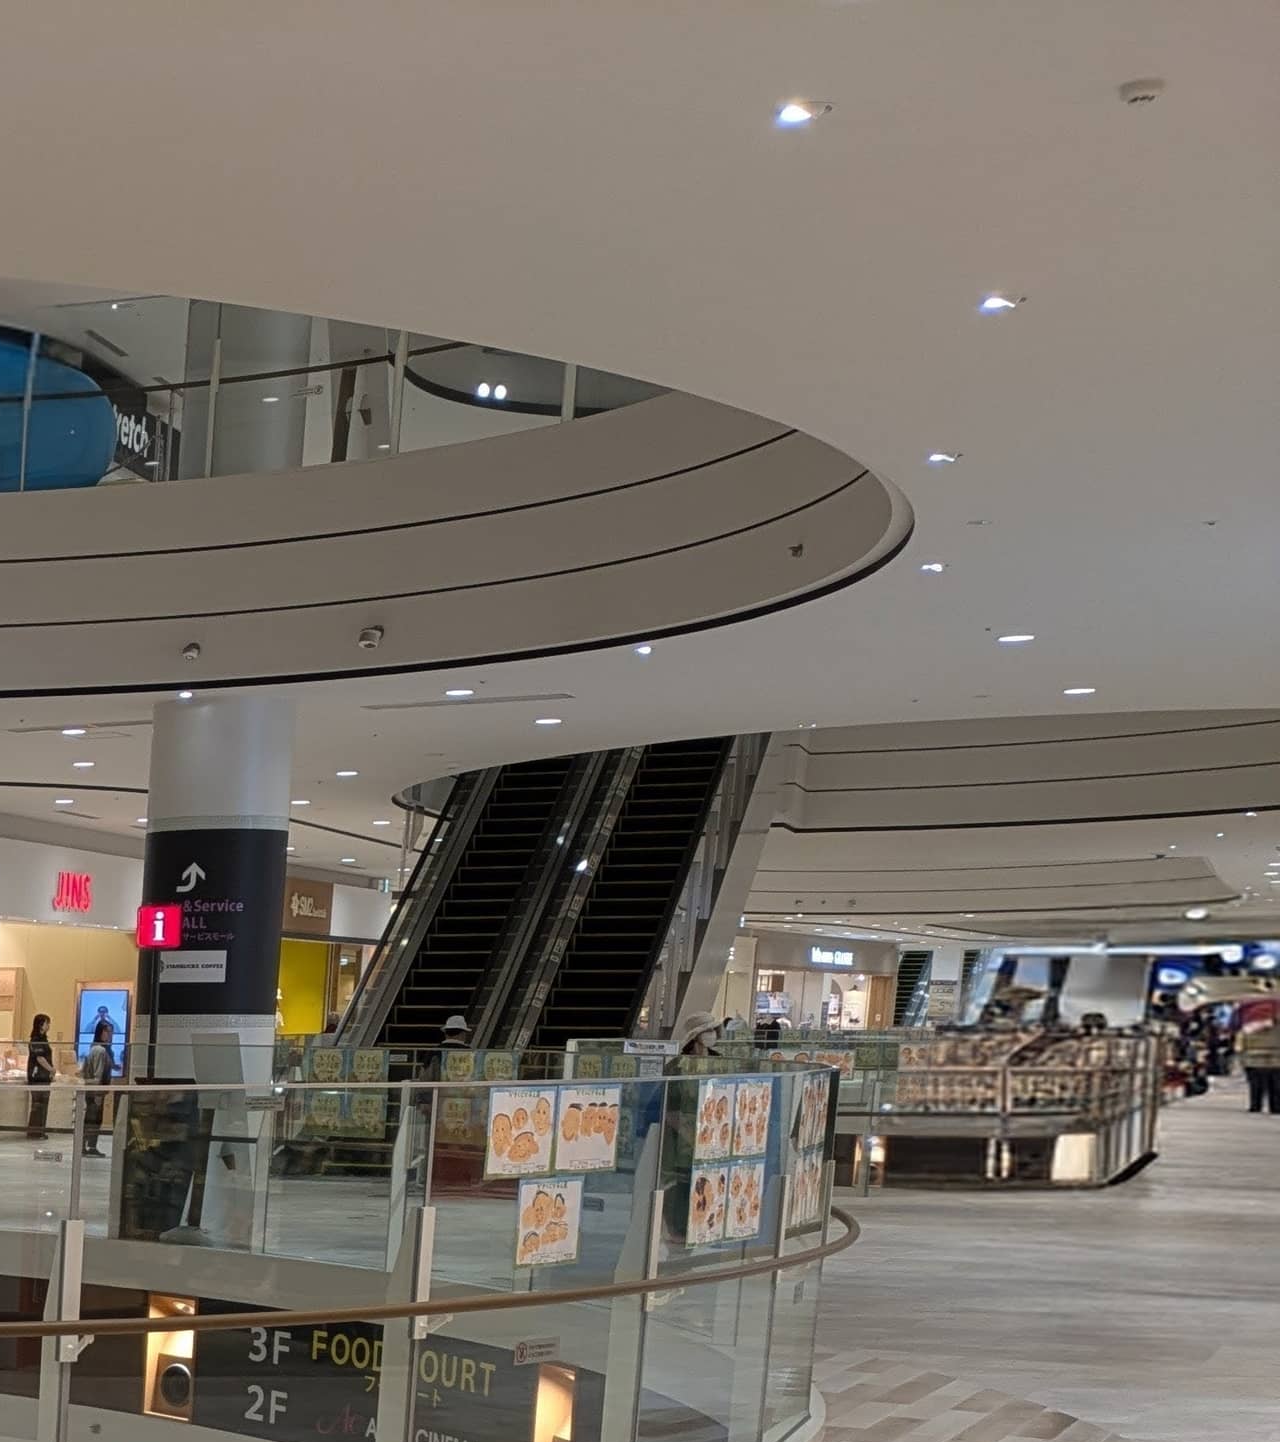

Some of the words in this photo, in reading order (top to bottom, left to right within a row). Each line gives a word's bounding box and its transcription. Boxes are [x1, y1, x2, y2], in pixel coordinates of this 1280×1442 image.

[53, 871, 92, 913] JINS
[182, 916, 208, 929] ALL
[248, 1326, 292, 1365] 3F
[419, 1350, 496, 1397] OURT
[244, 1384, 289, 1424] 2F
